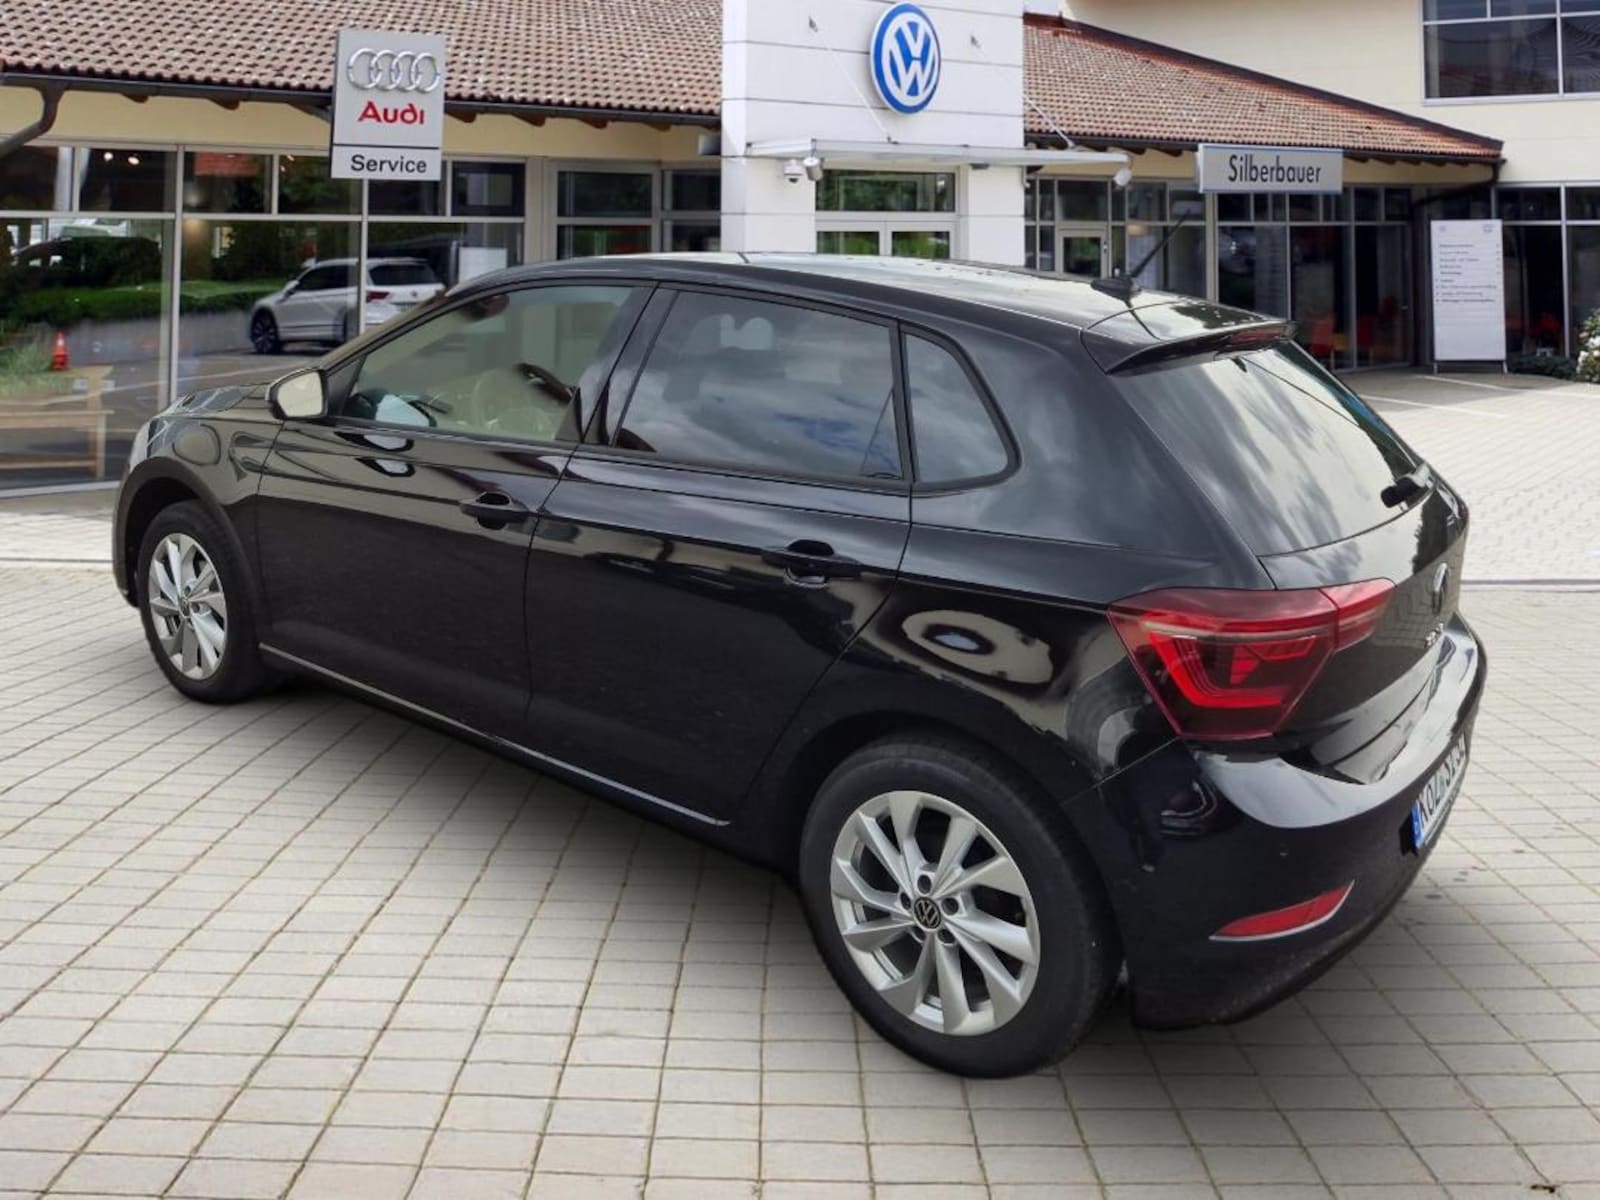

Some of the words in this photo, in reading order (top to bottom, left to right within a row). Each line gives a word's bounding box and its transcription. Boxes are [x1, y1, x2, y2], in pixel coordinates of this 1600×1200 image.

[881, 11, 938, 106] VW
[357, 100, 425, 125] Audi
[350, 154, 427, 173] Service
[1228, 153, 1321, 183] Silberbauer
